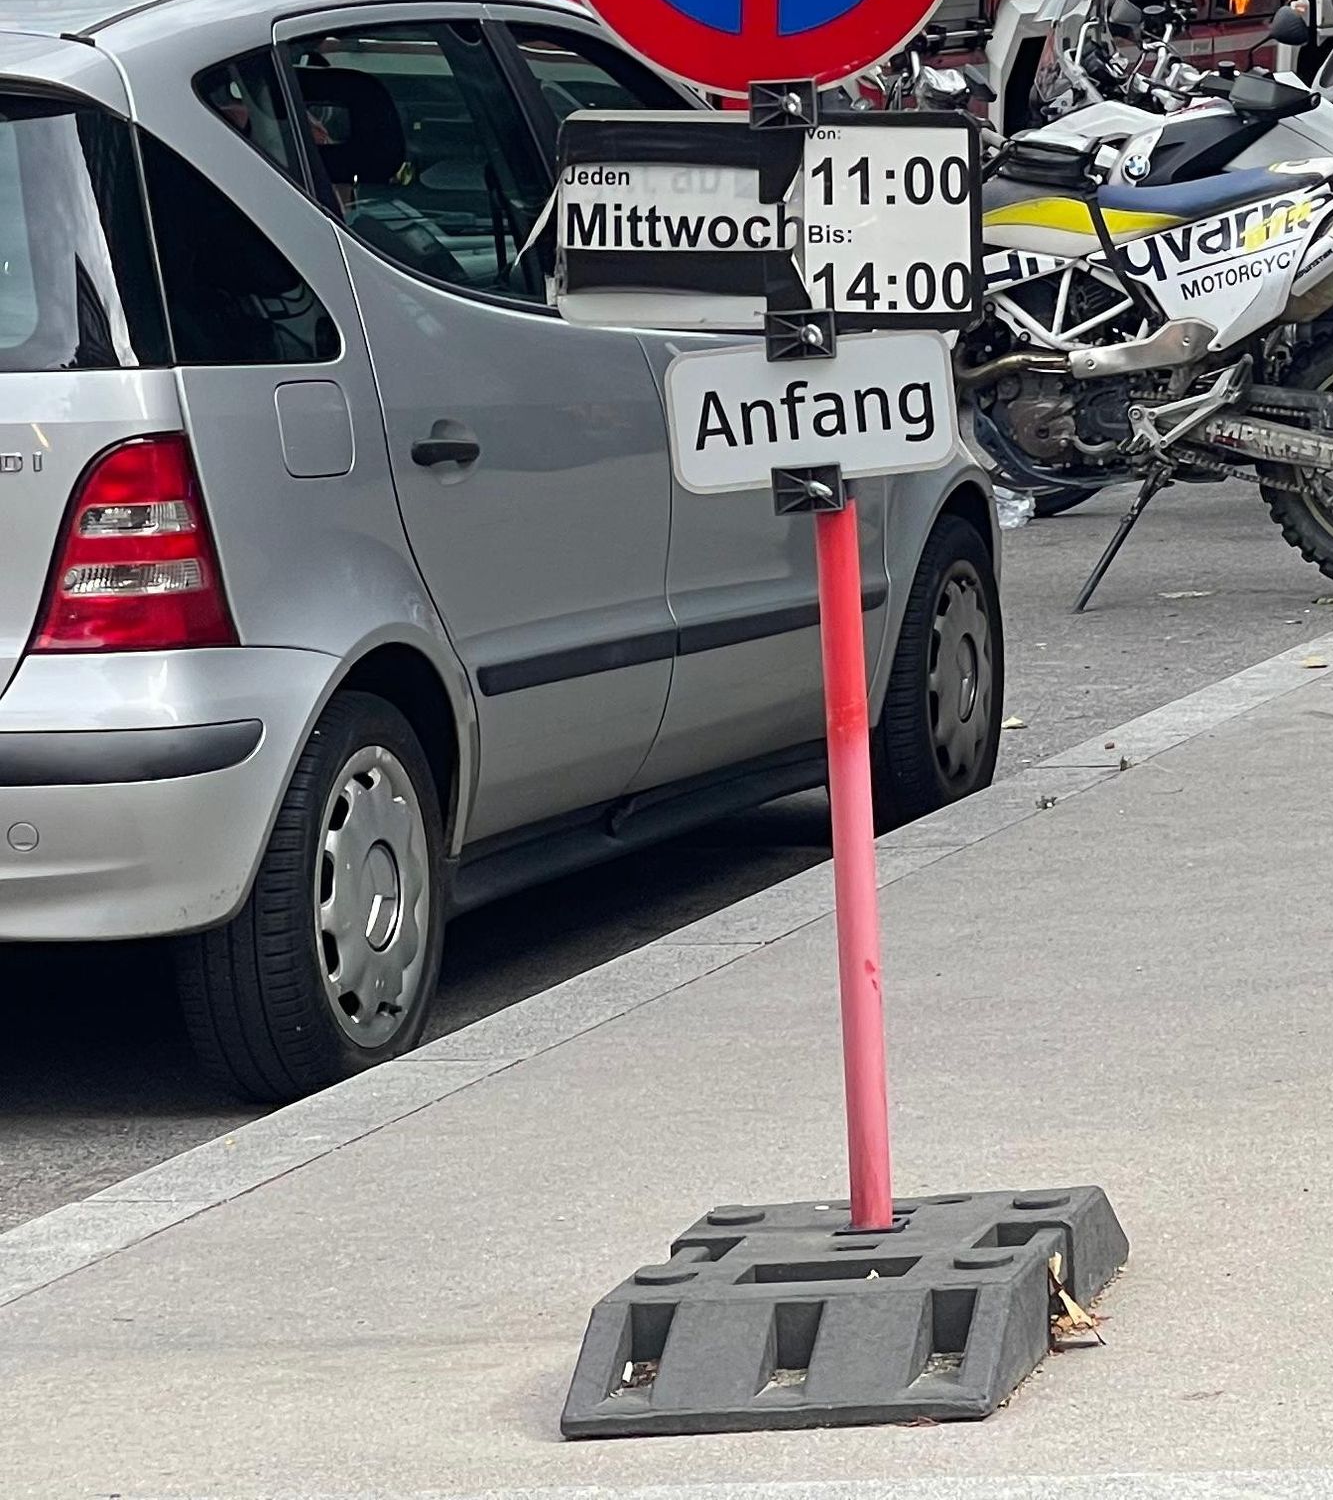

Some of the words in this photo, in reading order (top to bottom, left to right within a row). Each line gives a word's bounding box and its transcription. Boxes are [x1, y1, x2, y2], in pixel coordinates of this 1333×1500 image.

[807, 128, 842, 140] Von:
[564, 166, 630, 186] Jeden
[811, 156, 970, 205] 11:00
[566, 202, 804, 249] Mittwoch
[808, 225, 852, 244] Bis:
[812, 261, 973, 311] 14:00
[695, 380, 935, 451] Anfang
